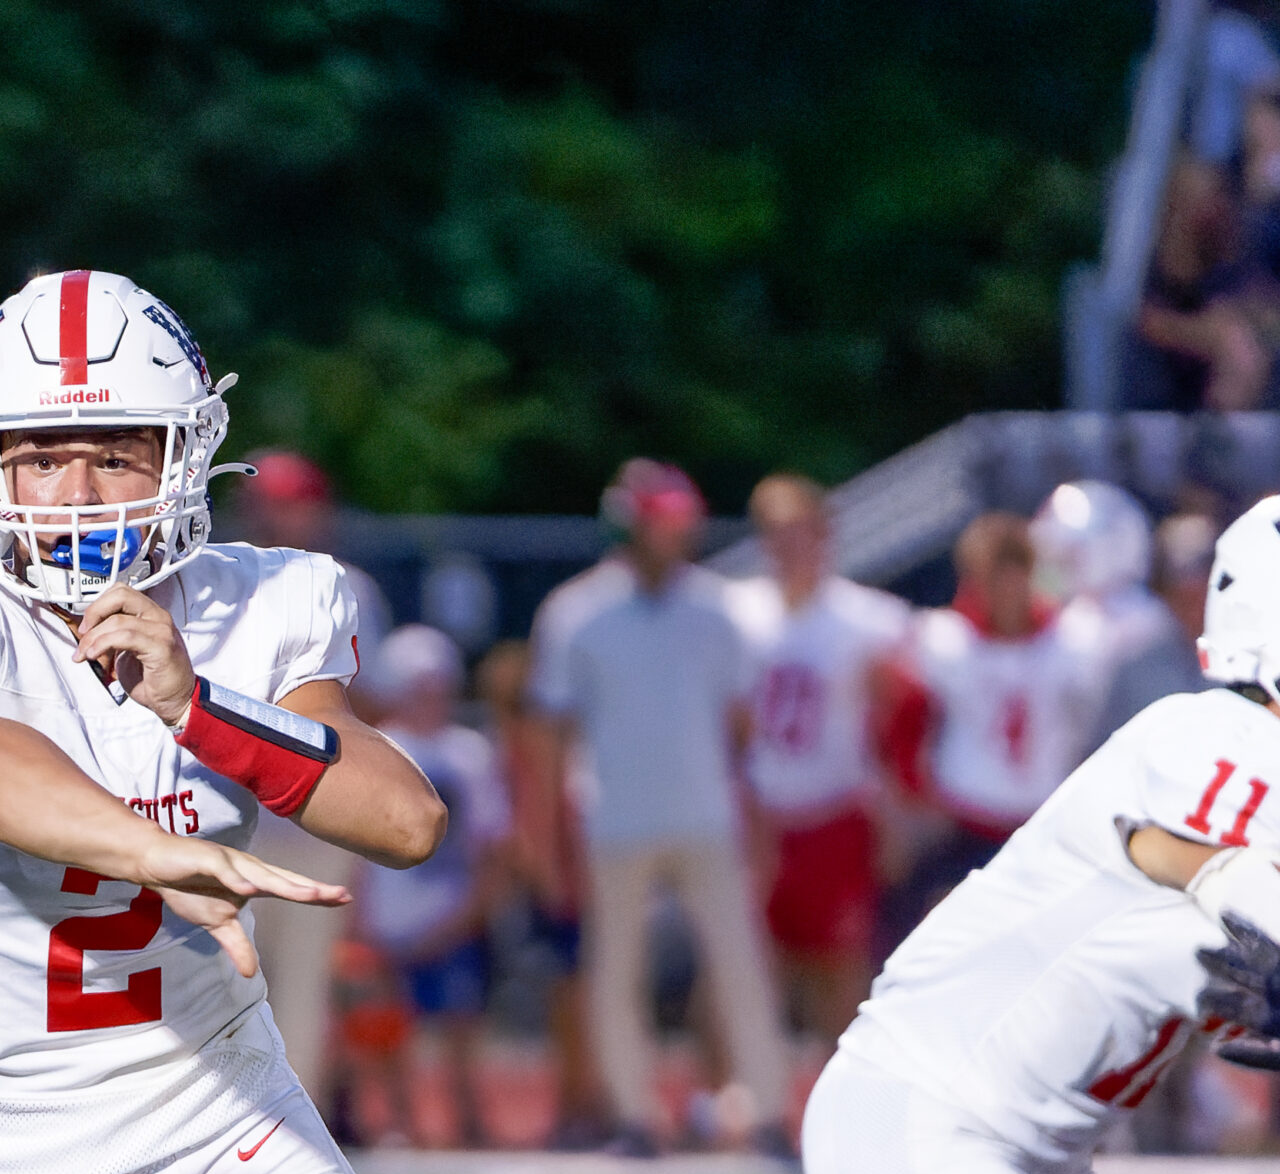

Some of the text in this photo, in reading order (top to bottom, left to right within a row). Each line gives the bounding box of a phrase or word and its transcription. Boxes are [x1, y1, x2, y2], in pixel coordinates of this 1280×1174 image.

[39, 388, 110, 405] Riddell
[1184, 758, 1269, 848] 11
[47, 866, 163, 1033] 2
